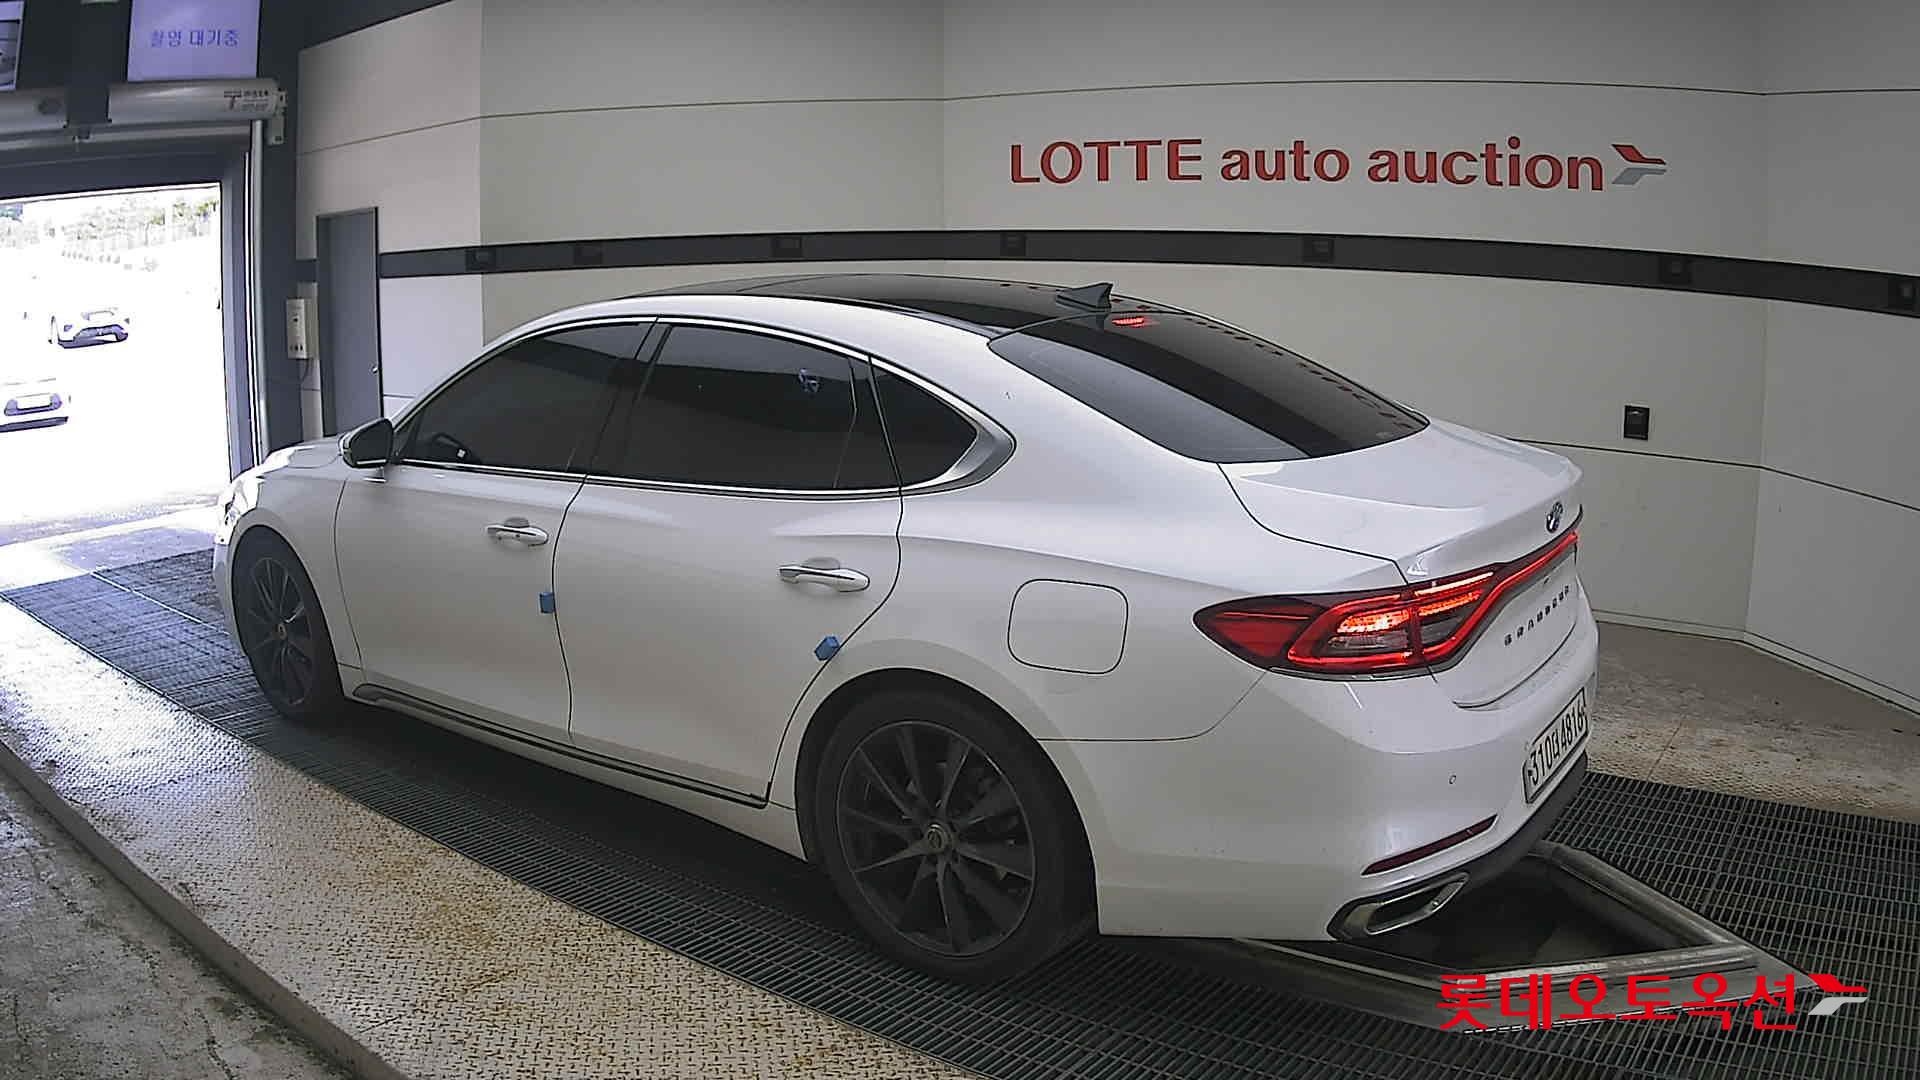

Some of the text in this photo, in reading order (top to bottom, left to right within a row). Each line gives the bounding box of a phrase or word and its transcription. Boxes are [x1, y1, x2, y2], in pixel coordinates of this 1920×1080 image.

[189, 29, 240, 48] 대기중
[1010, 136, 1604, 191] LOTTE auto auction
